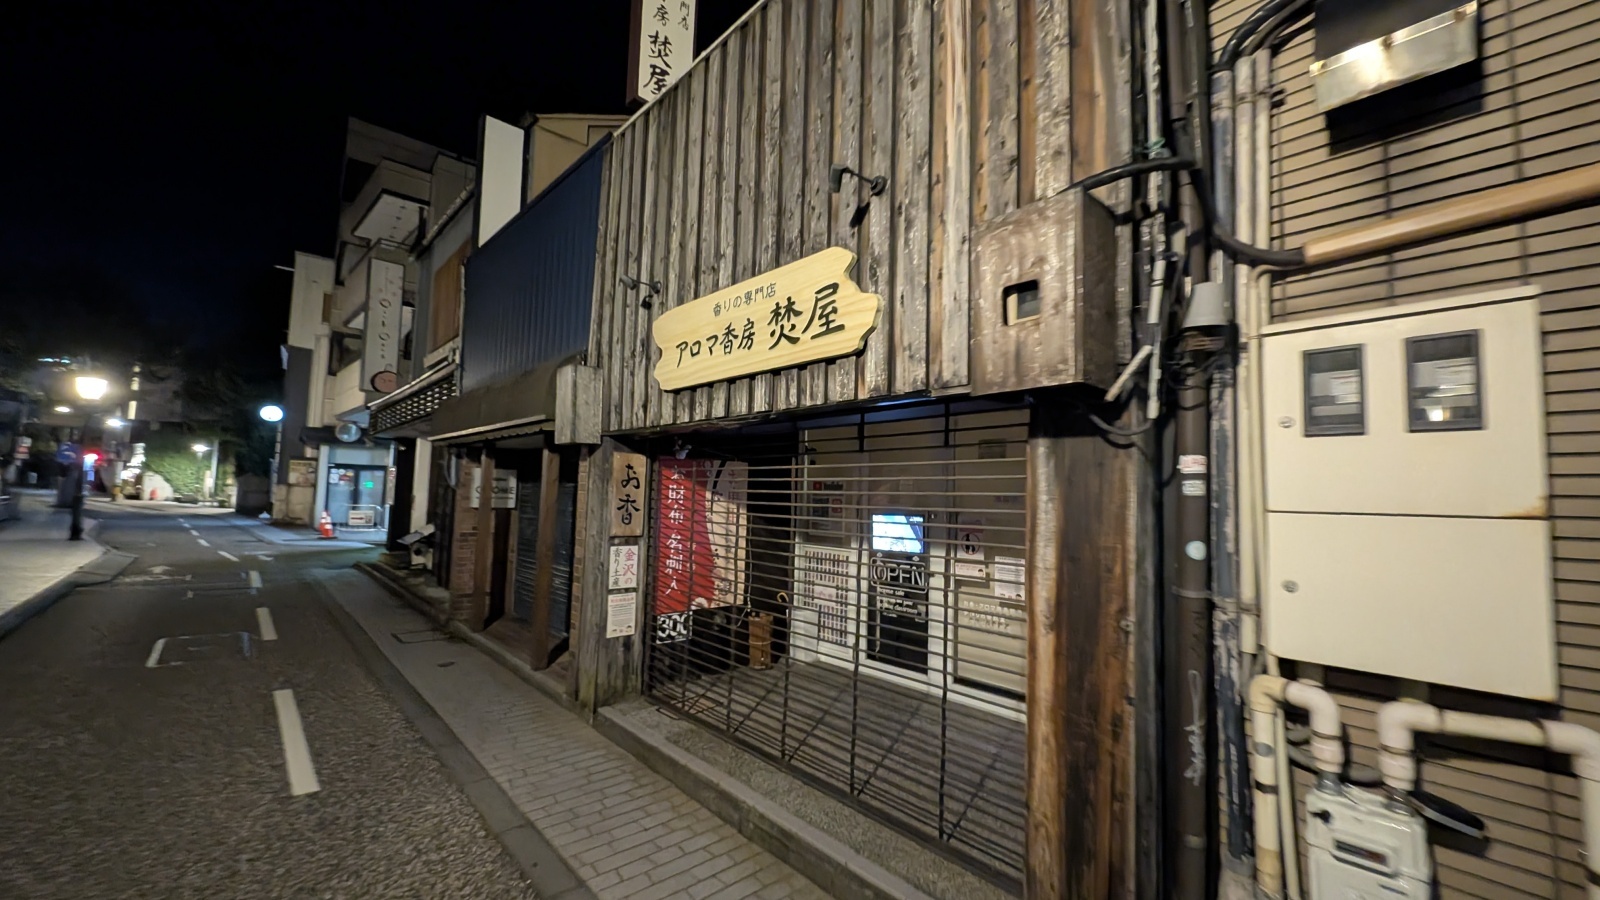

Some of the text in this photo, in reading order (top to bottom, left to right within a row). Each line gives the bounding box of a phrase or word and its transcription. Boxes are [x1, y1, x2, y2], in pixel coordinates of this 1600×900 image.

[713, 282, 777, 317] 香りの専門店
[675, 282, 846, 368] アロマ香房 焚屋
[616, 463, 641, 526] お香
[610, 547, 623, 588] 香り土産
[622, 547, 637, 585] 金沢の
[873, 562, 925, 587] OPEN
